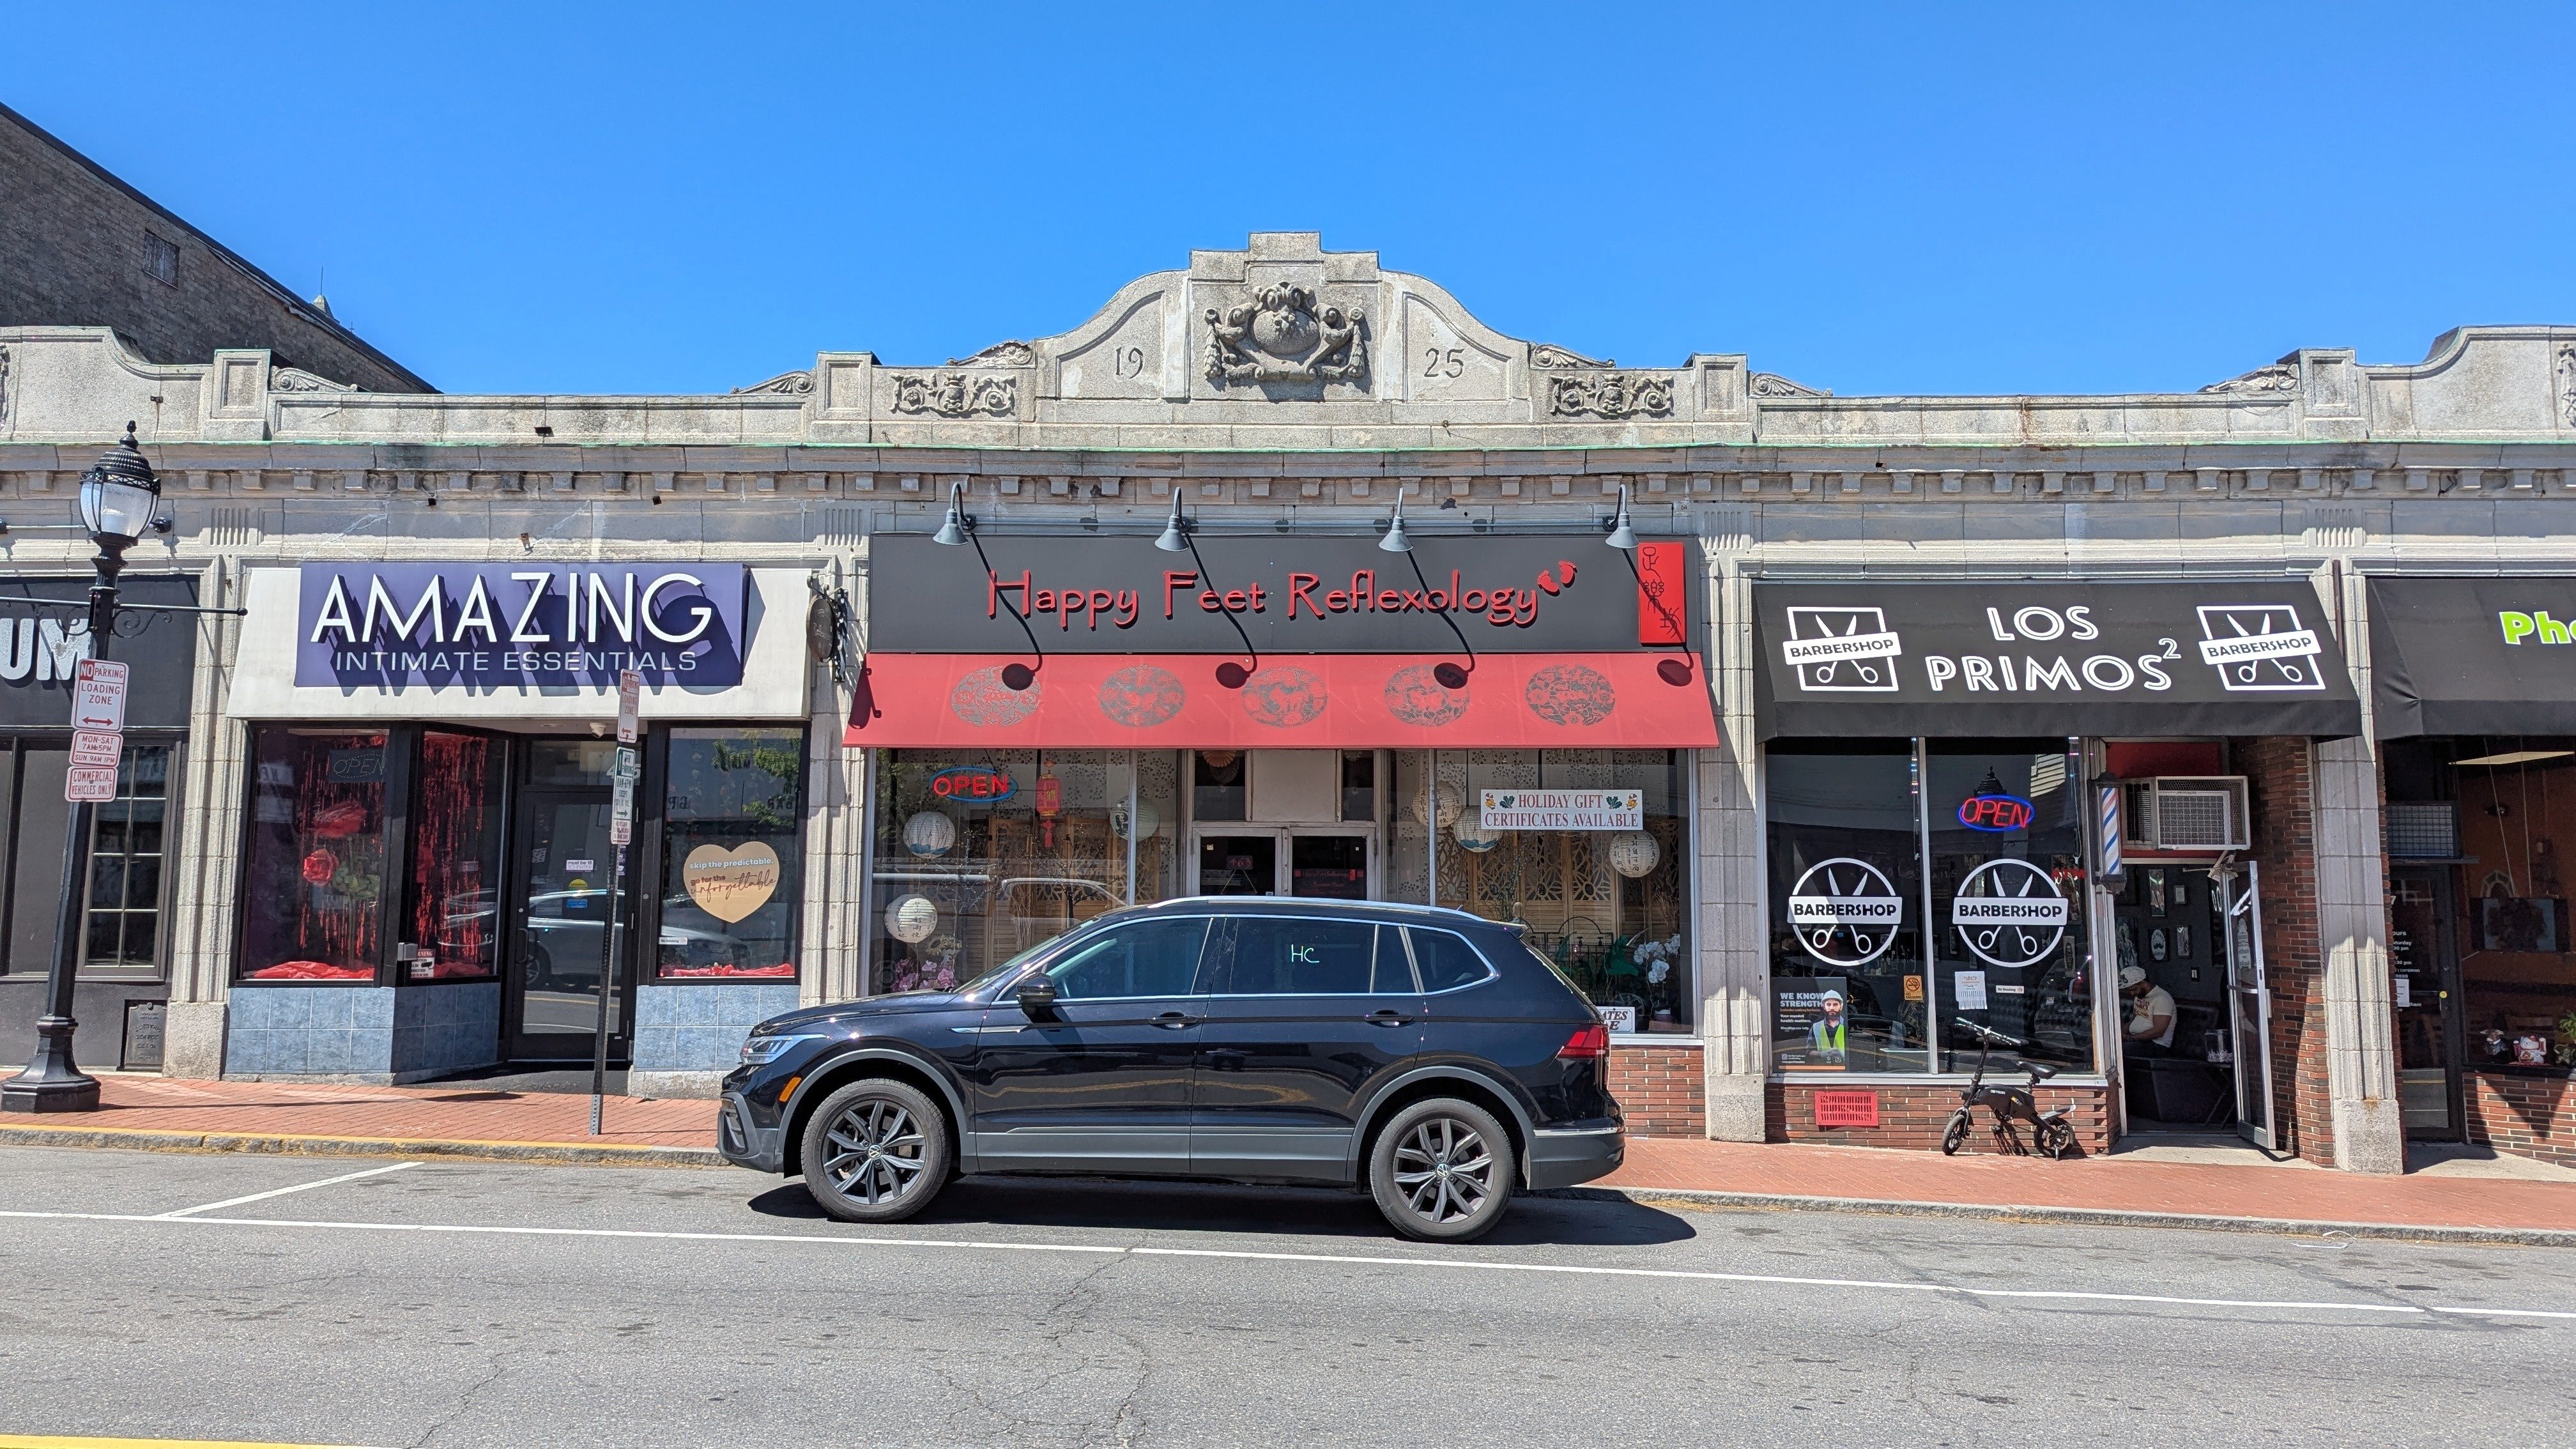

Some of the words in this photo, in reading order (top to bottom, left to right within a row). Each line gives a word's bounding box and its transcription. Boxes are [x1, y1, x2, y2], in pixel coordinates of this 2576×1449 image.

[1116, 346, 1144, 379] 19
[1424, 348, 1465, 379] 25
[310, 572, 712, 643] AMAZING
[988, 569, 1139, 631] Happy
[1164, 569, 1266, 620] Feet
[1287, 569, 1538, 628] Reflexology
[1986, 606, 2098, 641] LOS
[2499, 611, 2576, 645] Ph
[1790, 640, 1894, 658] BARBERSHOP
[2207, 637, 2312, 658] BARBERSHOP
[336, 652, 489, 671] INTIMATE
[504, 652, 696, 671] ESSENTIALS
[80, 663, 93, 677] NO
[95, 667, 124, 678] PARKING
[81, 682, 120, 694] LOADING
[89, 694, 112, 705] ZONE
[622, 694, 637, 705] LOADING
[625, 705, 634, 715] ZONE
[82, 735, 114, 744] MON-SAT
[334, 758, 385, 776] OPEN
[73, 770, 112, 782] COMMERCIAL
[72, 785, 95, 795] VEHICLES
[98, 785, 112, 795] ONLY
[932, 774, 1009, 796] OPEN
[1518, 794, 1570, 808] HOLIDAY
[1575, 794, 1603, 808] GIFT
[1485, 813, 1568, 827] CERTIFICATES
[1572, 813, 1638, 827] AVAILABLE
[1961, 797, 2030, 829] OPEN
[689, 862, 707, 870] skip
[723, 857, 774, 868] predictable.
[691, 878, 700, 887] go
[691, 869, 777, 903] unforgettable
[1793, 903, 1896, 917] BARBERSHOP
[1959, 905, 2062, 918] BARBERSHOP
[1291, 944, 1319, 963] HC
